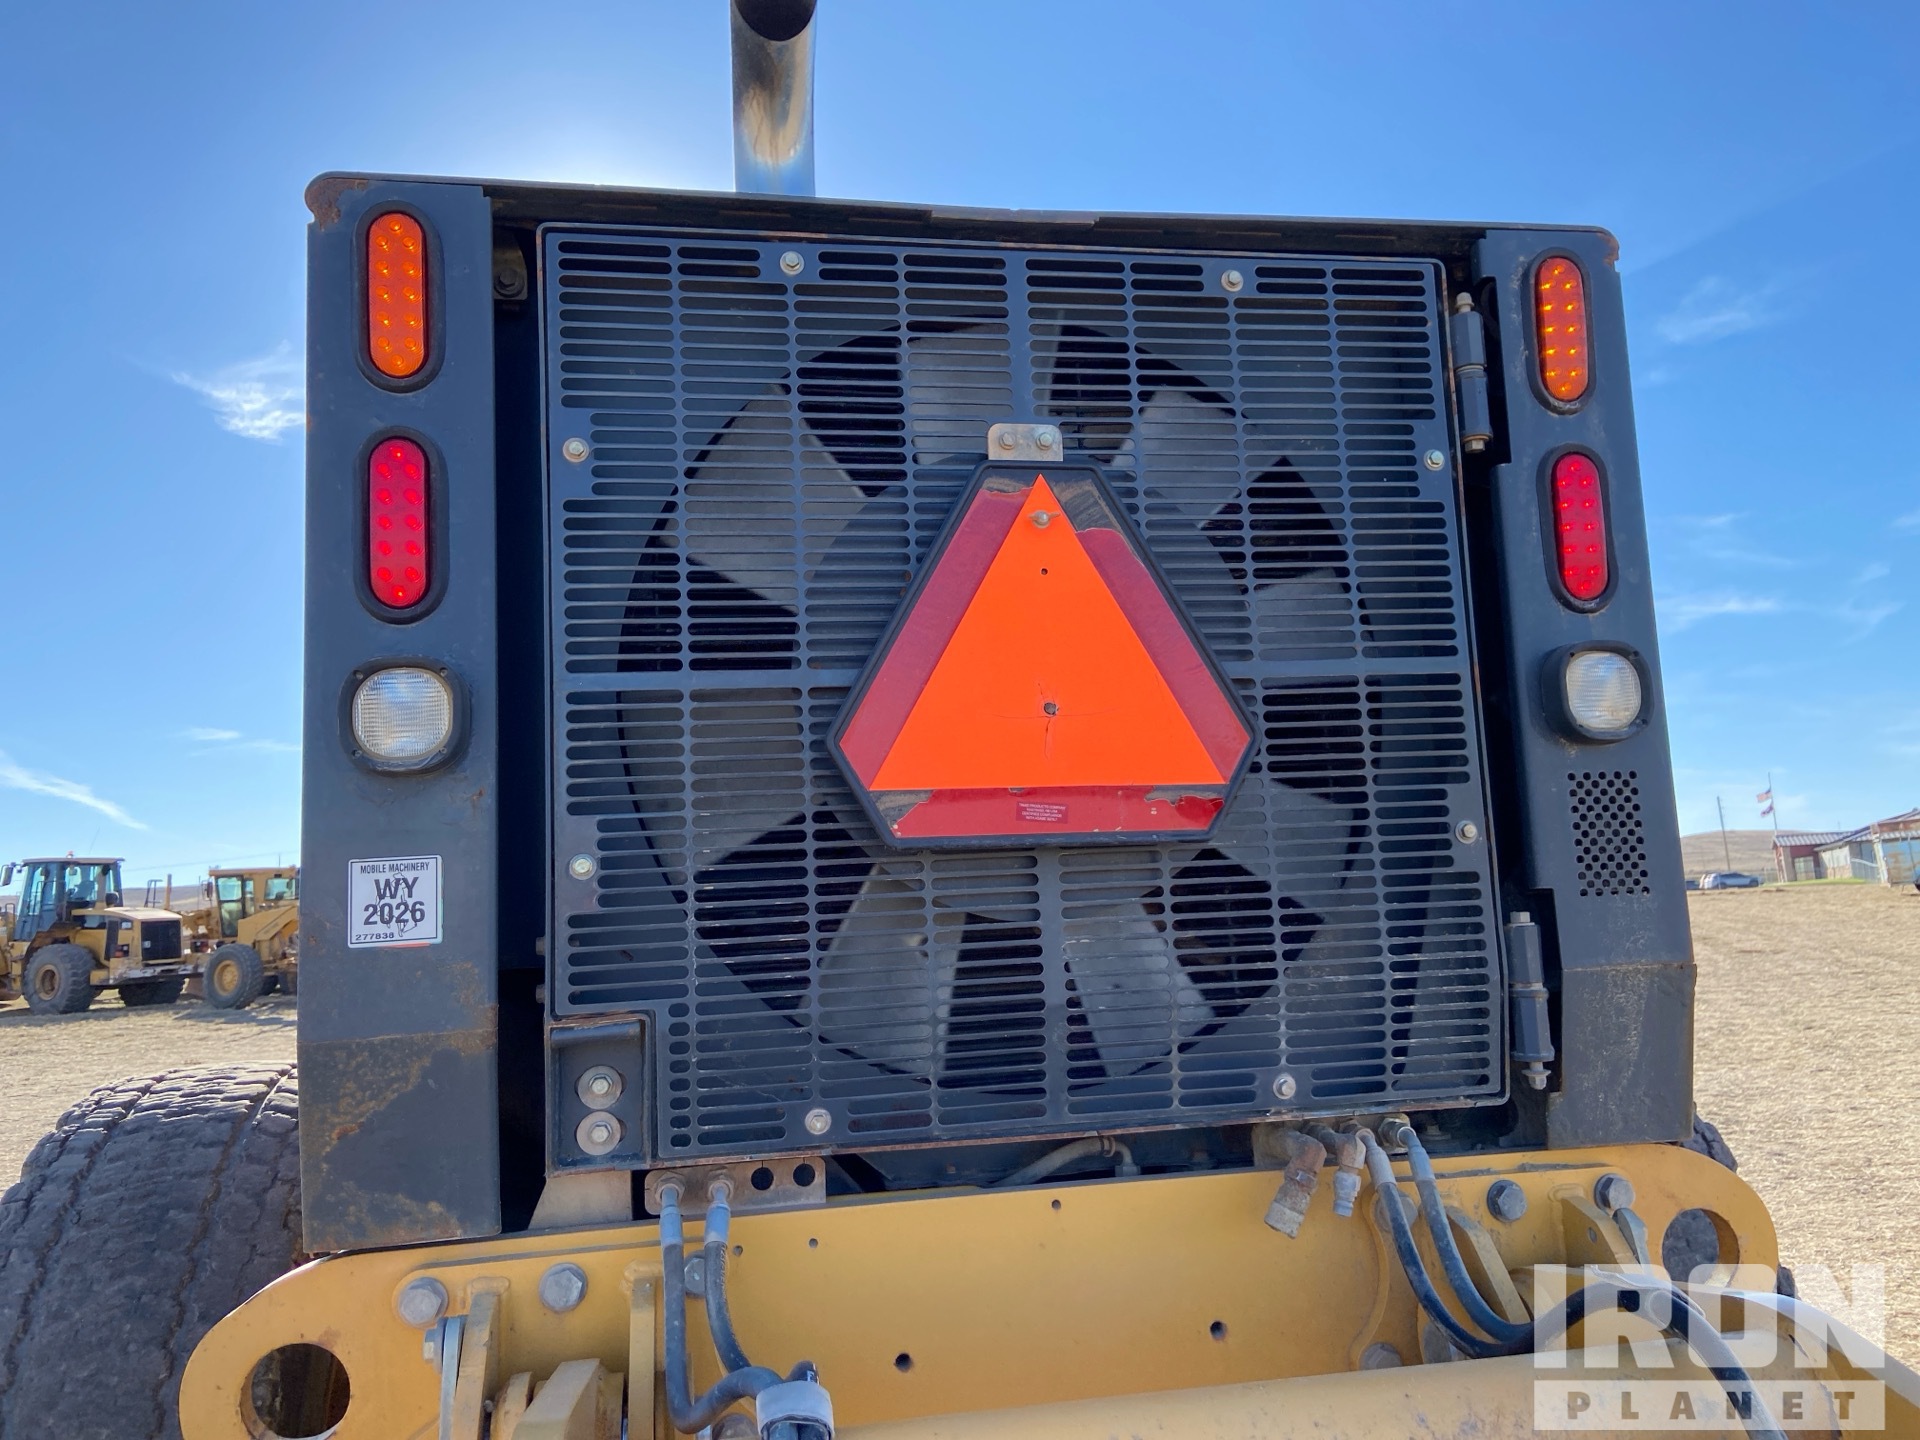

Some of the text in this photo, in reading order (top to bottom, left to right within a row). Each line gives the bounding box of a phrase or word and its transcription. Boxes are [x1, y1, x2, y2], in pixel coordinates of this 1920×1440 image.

[361, 862, 430, 874] MOBILE MACHINERY
[374, 877, 419, 900] WY
[364, 901, 425, 926] 2026
